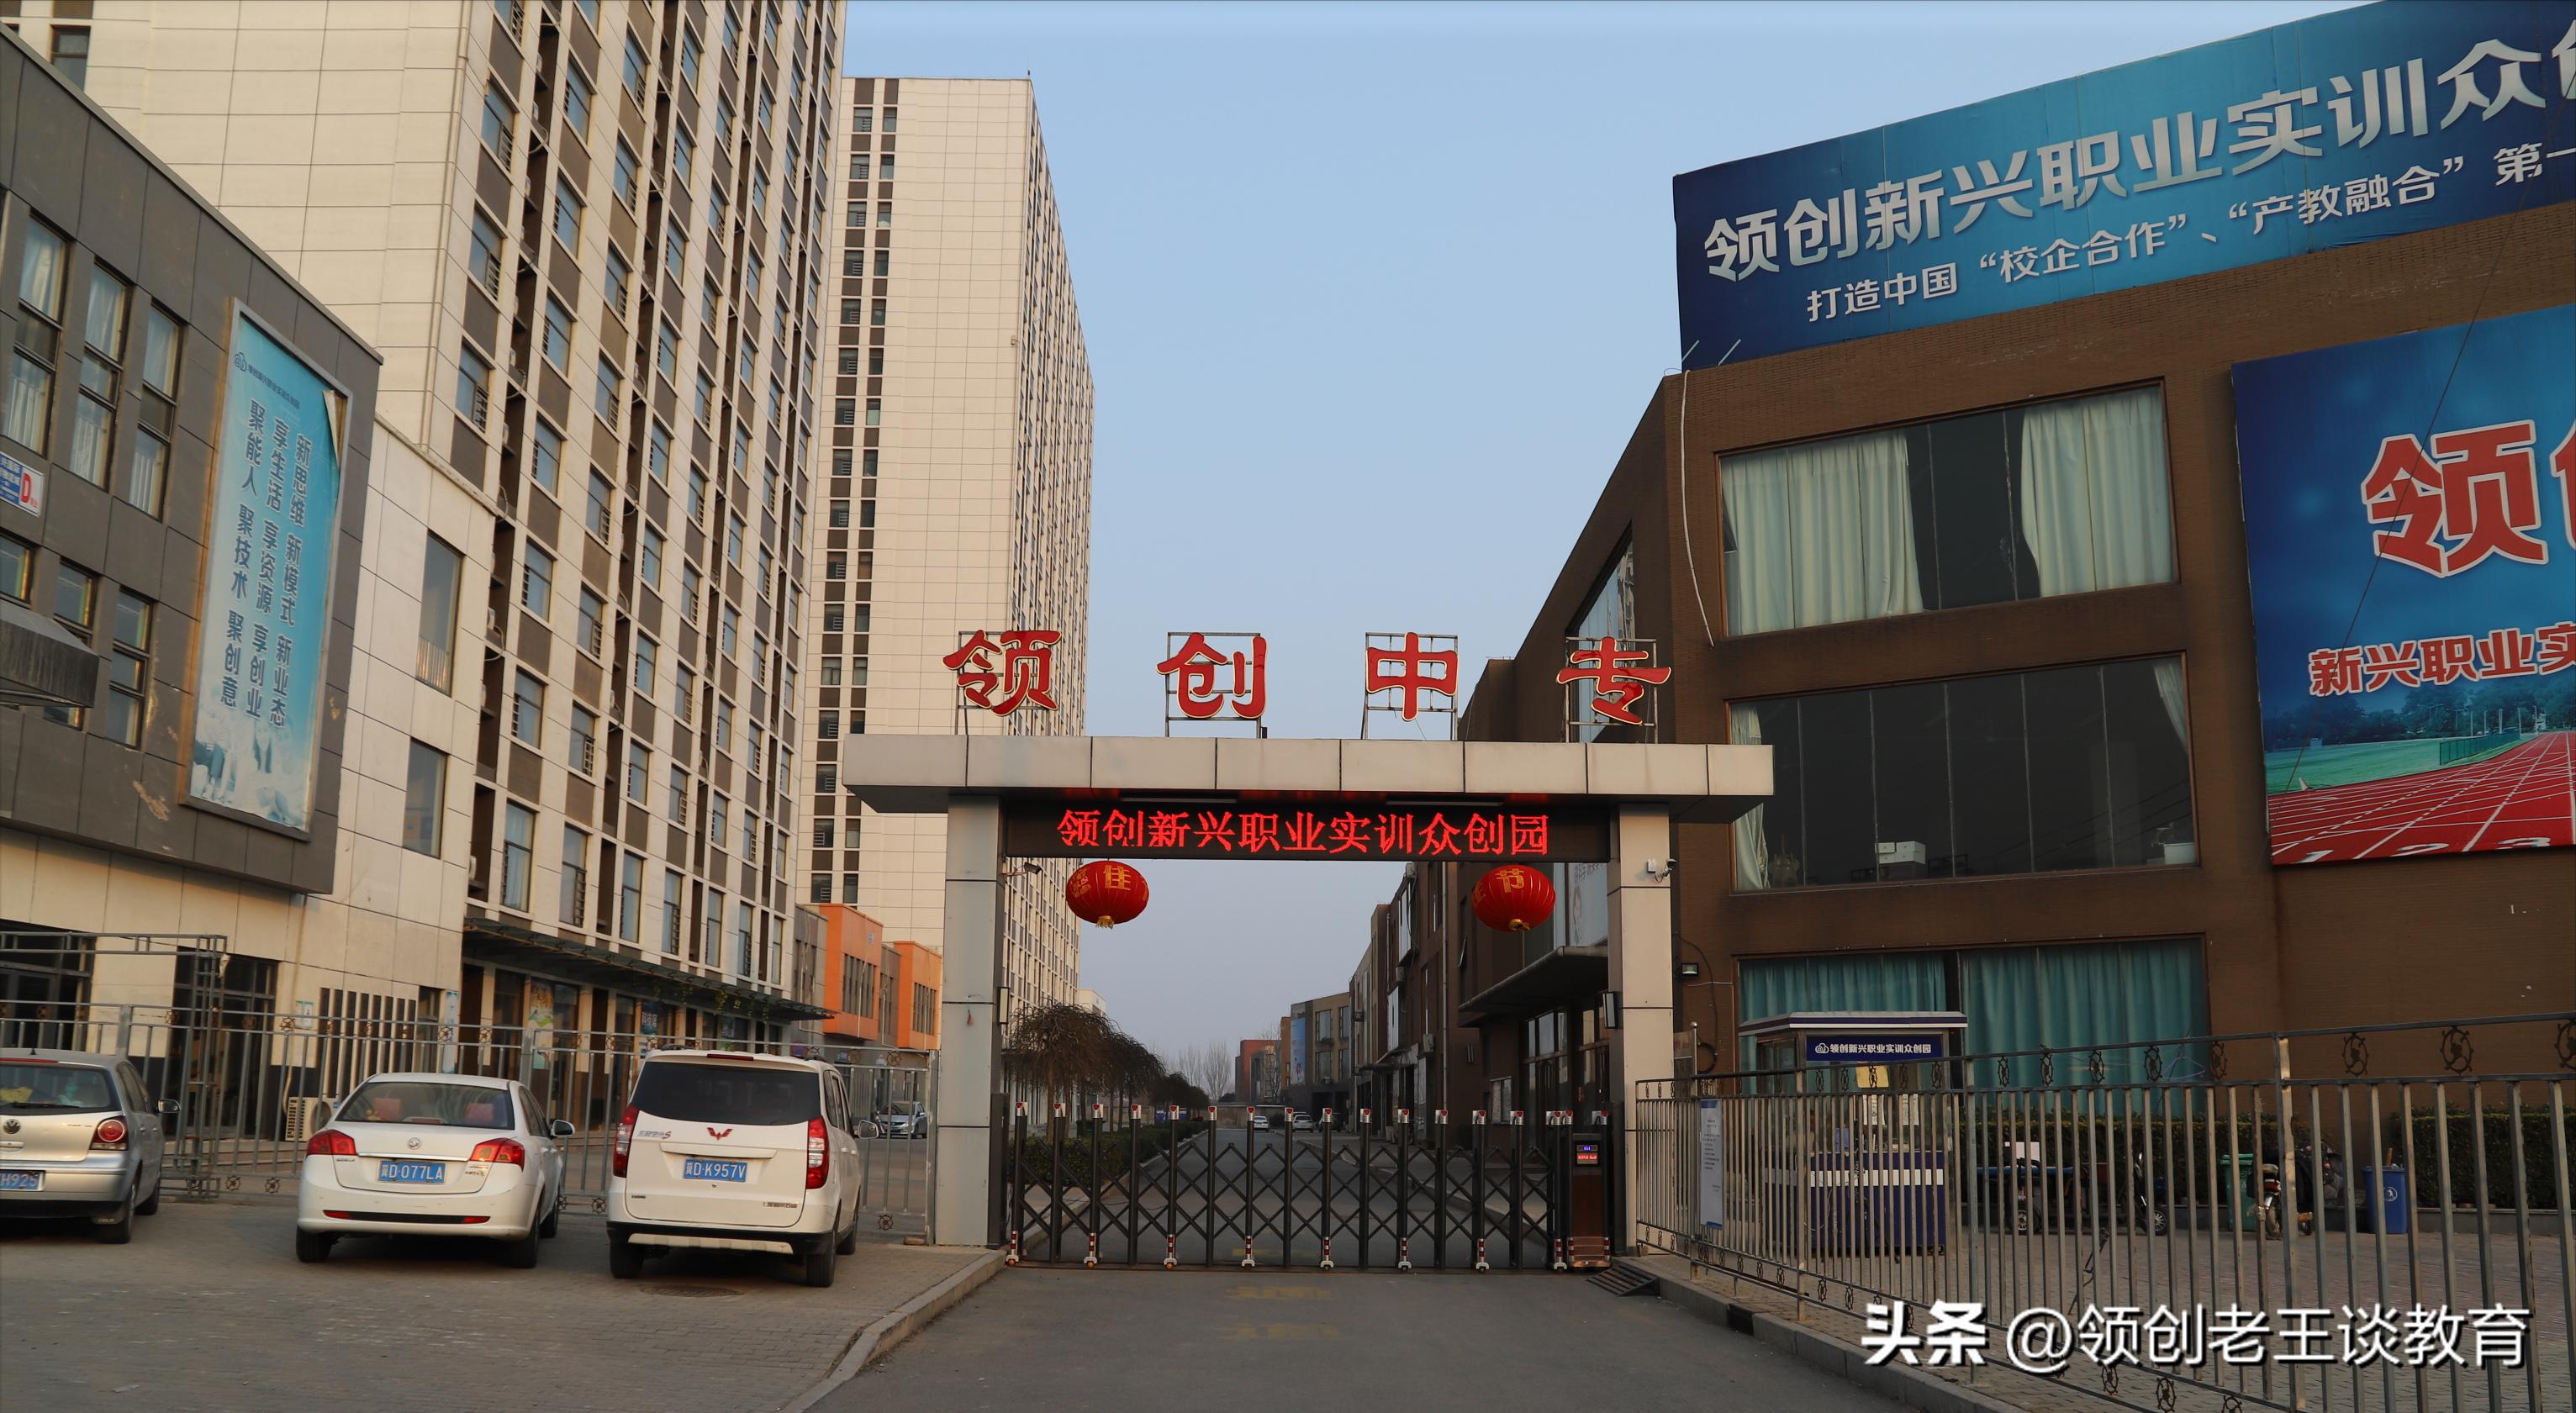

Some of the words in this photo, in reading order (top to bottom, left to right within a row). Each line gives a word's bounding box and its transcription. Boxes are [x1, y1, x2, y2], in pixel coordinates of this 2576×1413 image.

[20, 472, 31, 503] D
[242, 399, 265, 498] 聚能人
[266, 417, 288, 512] 享生活
[290, 435, 312, 528] 新思维
[2361, 419, 2576, 578] 领
[230, 504, 255, 600] 聚技术
[256, 519, 279, 614] 享资源
[279, 535, 302, 627] 新模式
[220, 609, 244, 709] 聚创意
[245, 624, 268, 720] 享创业
[269, 635, 292, 728] 新业态
[1057, 809, 1549, 856] 领创新兴职业实训众创园
[1830, 1044, 1931, 1054] 领创新兴职业实训众创园
